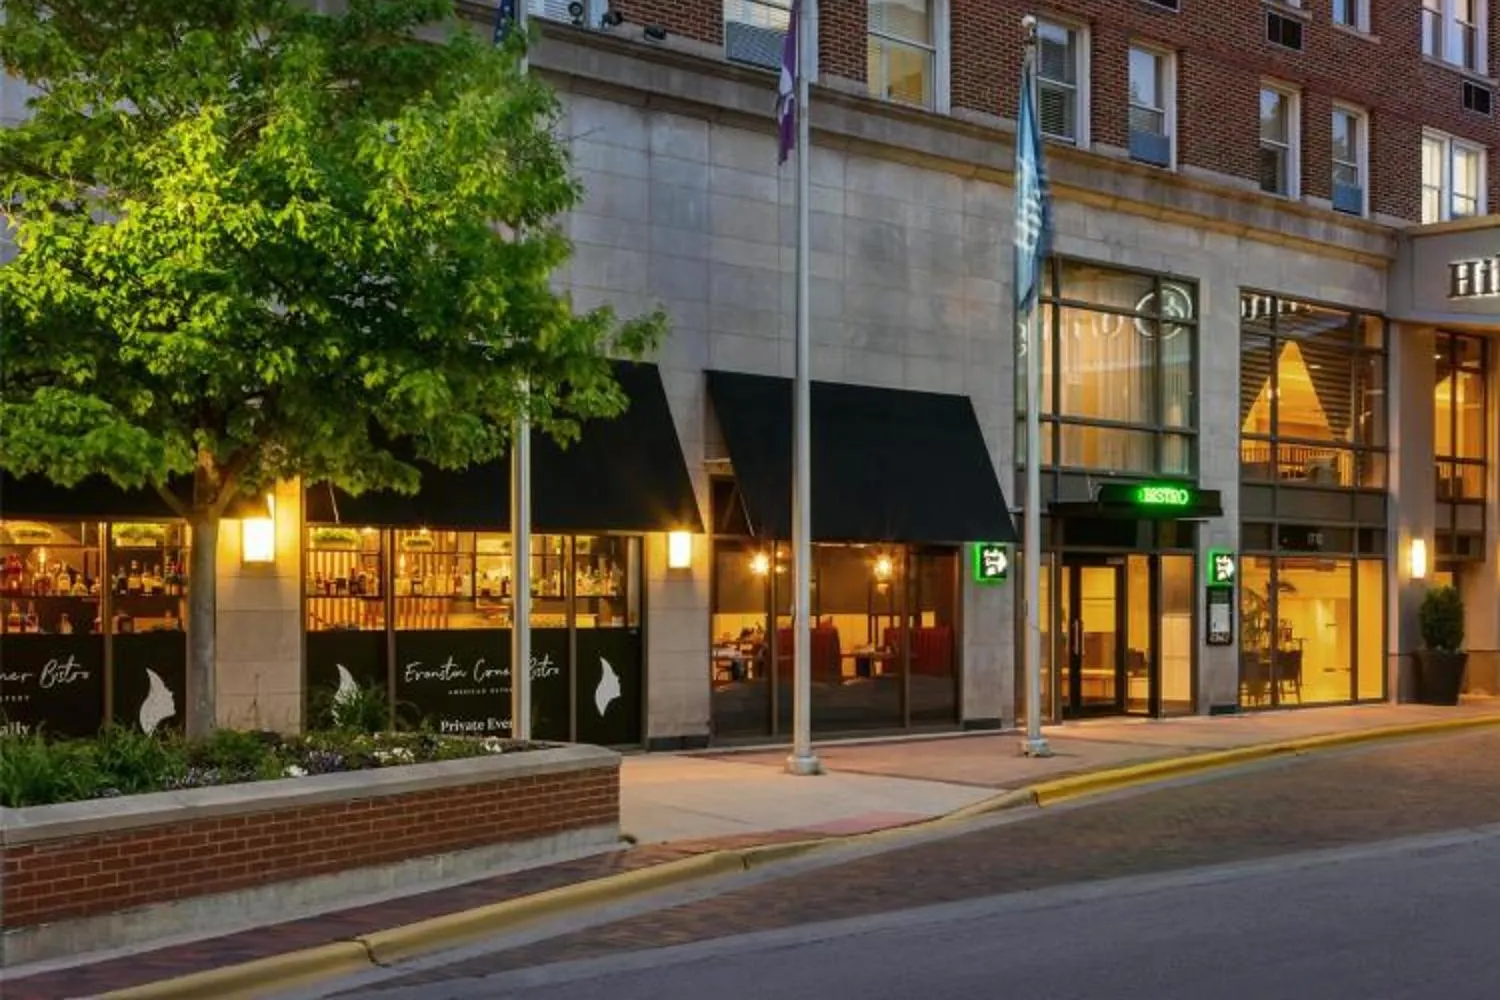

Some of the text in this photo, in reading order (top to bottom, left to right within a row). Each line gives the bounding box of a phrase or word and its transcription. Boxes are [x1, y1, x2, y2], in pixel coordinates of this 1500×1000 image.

[0, 653, 90, 689] ner Bistro
[404, 653, 468, 683] Evanston
[473, 656, 513, 683] Corne
[0, 721, 31, 738] ally
[440, 716, 513, 733] Private Eve
